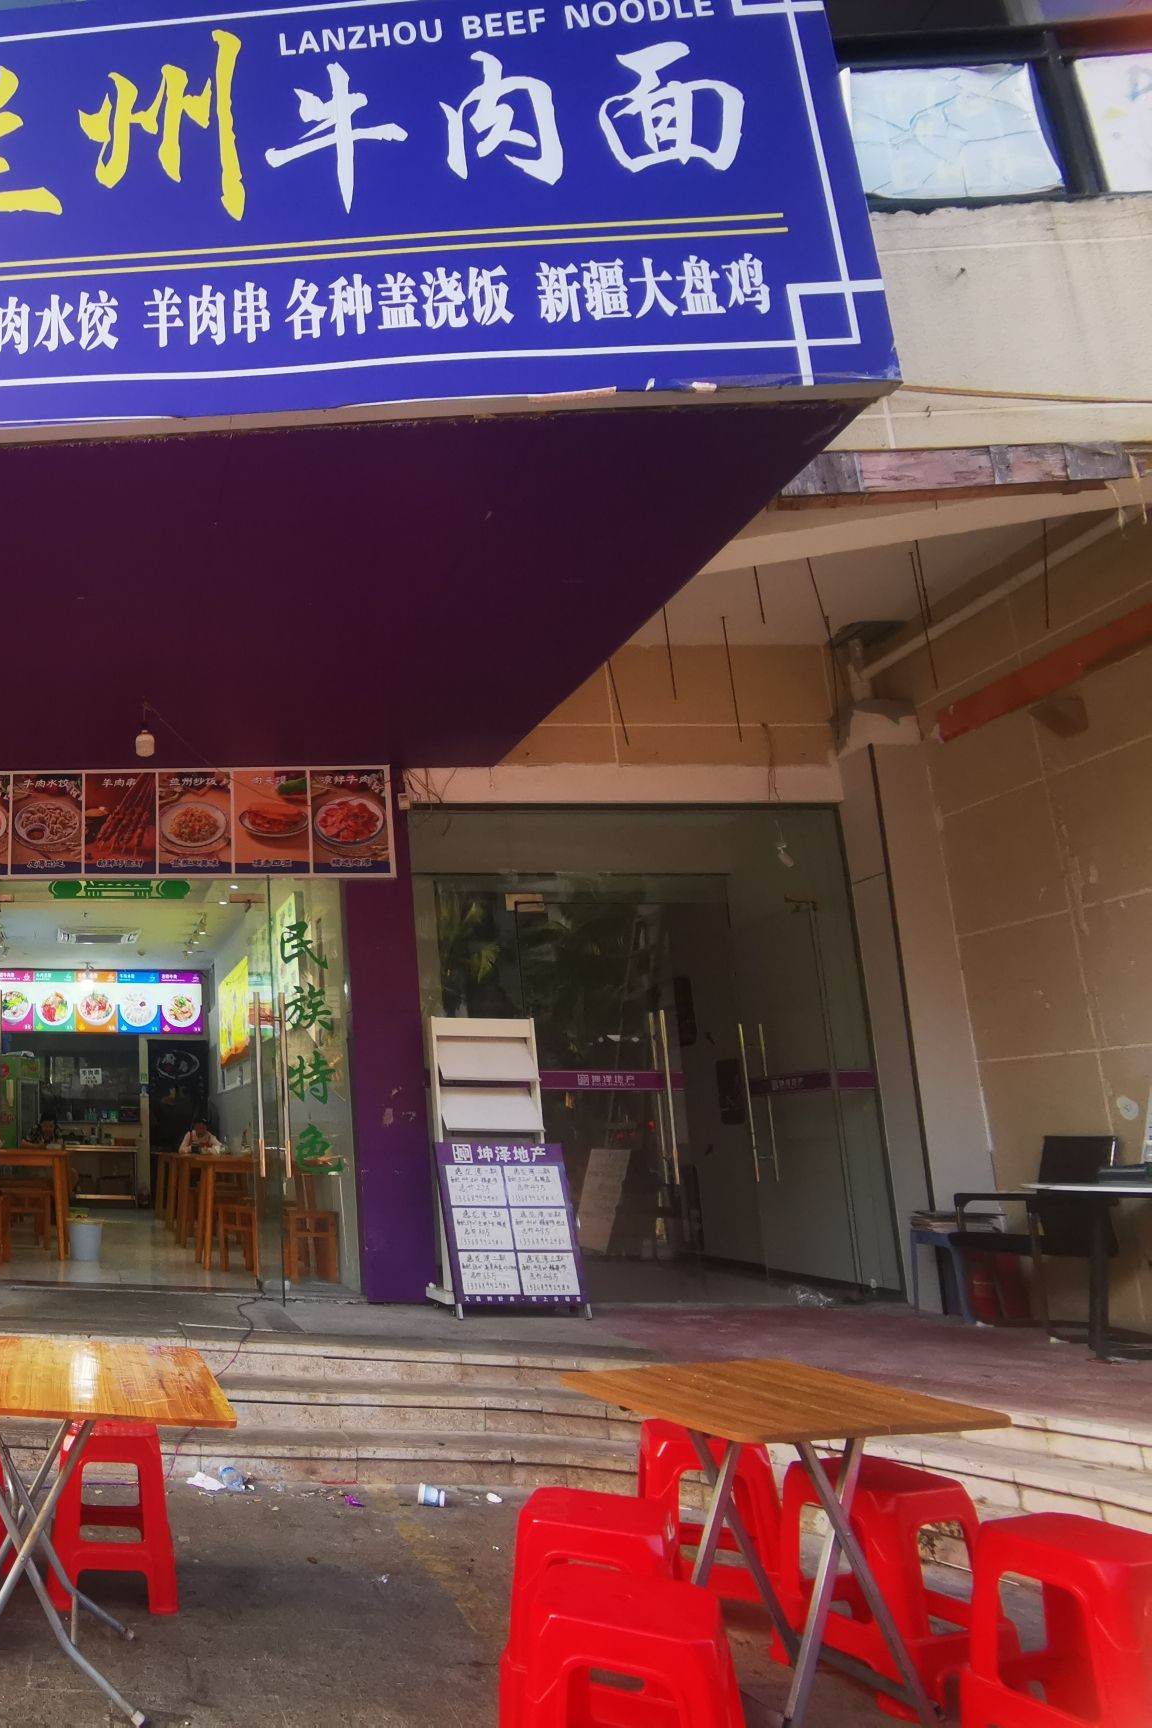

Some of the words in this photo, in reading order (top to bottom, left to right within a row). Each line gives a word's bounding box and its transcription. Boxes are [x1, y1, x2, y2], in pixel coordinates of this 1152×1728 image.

[278, 18, 444, 57] LANZHOU
[462, 8, 547, 41] BEEF
[564, 0, 716, 30] NOODLE
[142, 281, 270, 350] 羊肉串
[285, 265, 516, 342] 各种盖浇饭
[537, 252, 772, 324] 新疆大盘鸡
[23, 778, 70, 789] 牛肉水饺
[101, 777, 137, 789] 羊肉串
[280, 920, 344, 1173] 民族特色
[476, 1145, 546, 1163] 坤泽地产
